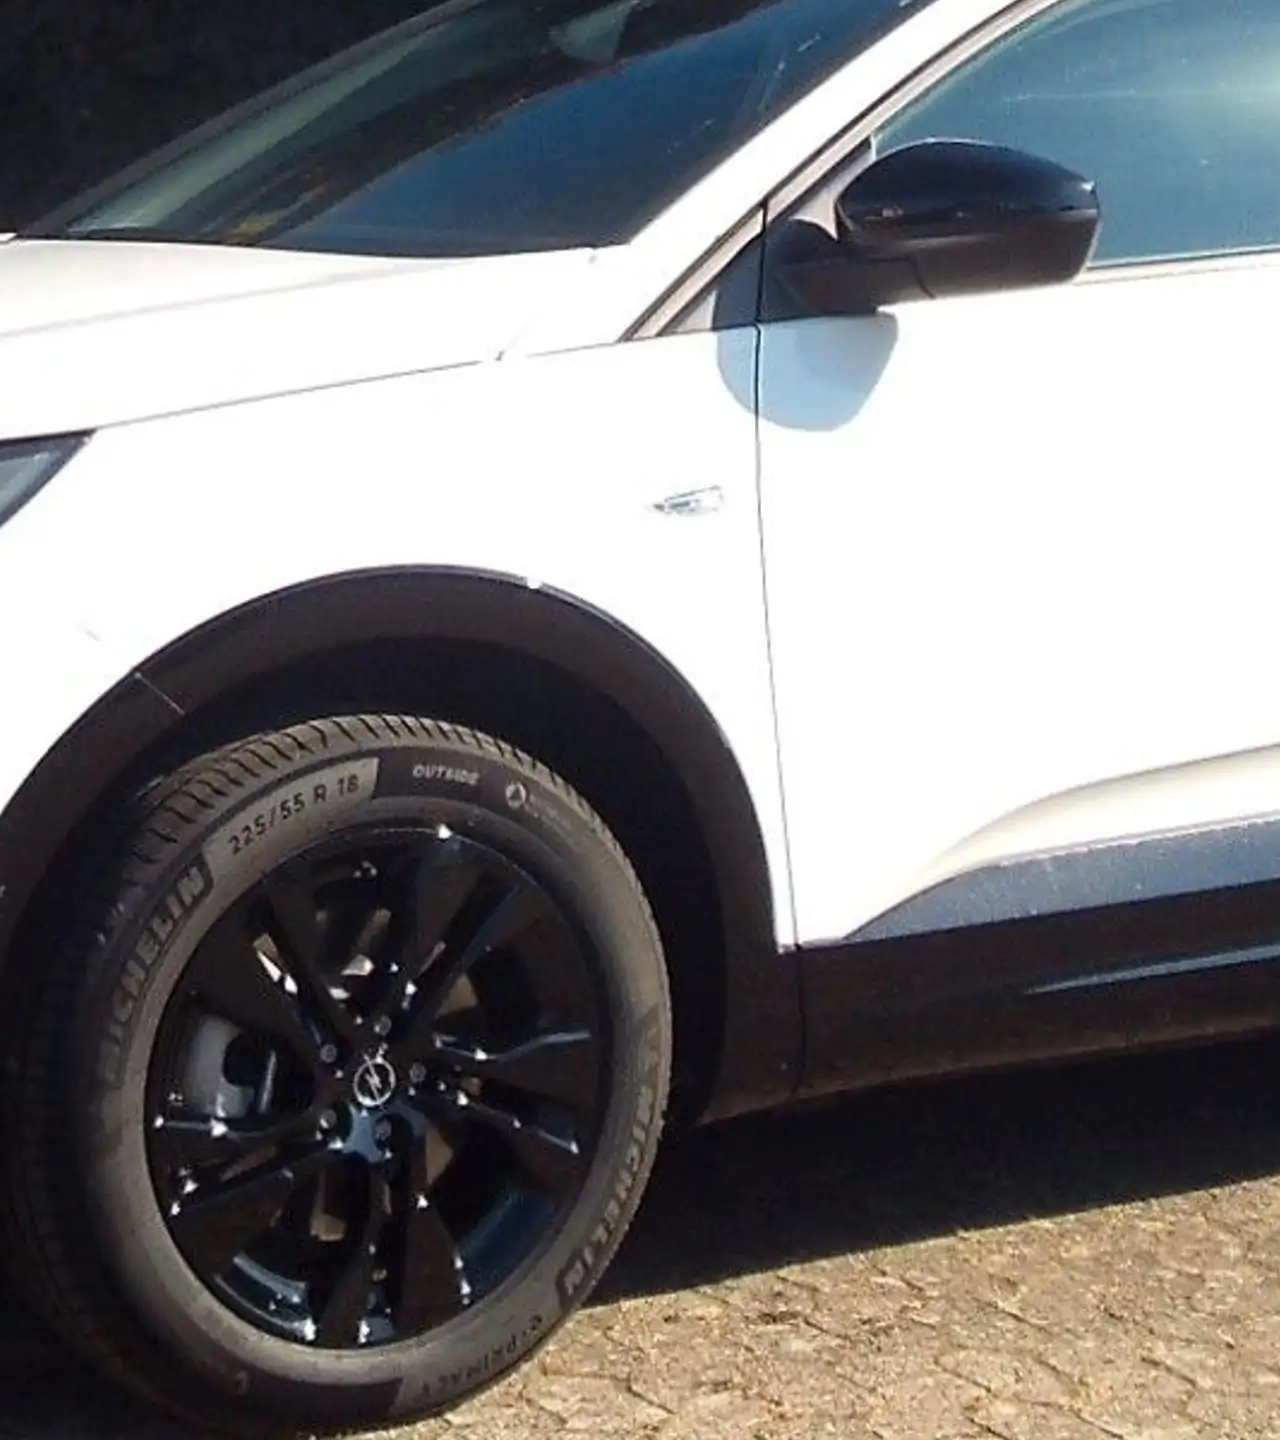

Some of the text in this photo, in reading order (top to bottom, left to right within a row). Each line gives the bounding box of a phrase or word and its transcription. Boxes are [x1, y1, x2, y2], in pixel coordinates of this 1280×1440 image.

[411, 763, 481, 787] OUTSIDE
[227, 772, 361, 856] 225/55 R 18
